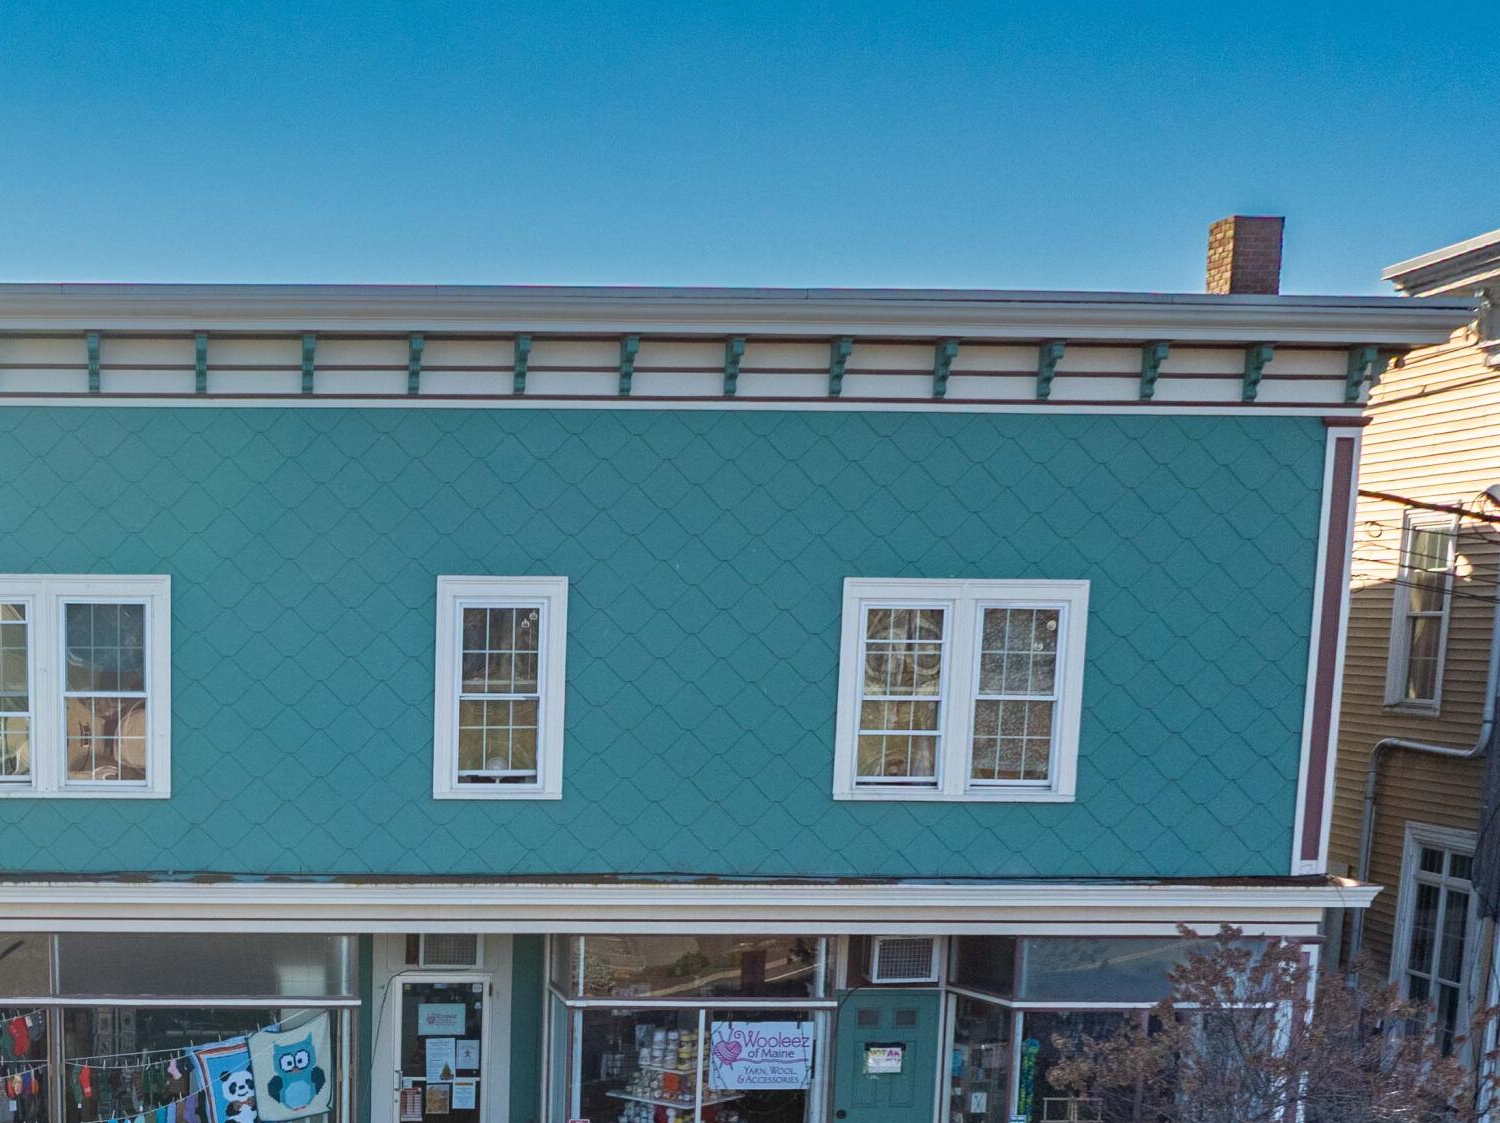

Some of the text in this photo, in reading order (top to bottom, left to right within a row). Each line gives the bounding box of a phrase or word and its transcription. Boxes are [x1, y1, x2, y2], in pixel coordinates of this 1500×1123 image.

[734, 1030, 810, 1048] Wooleez
[747, 1049, 795, 1058] of Maine
